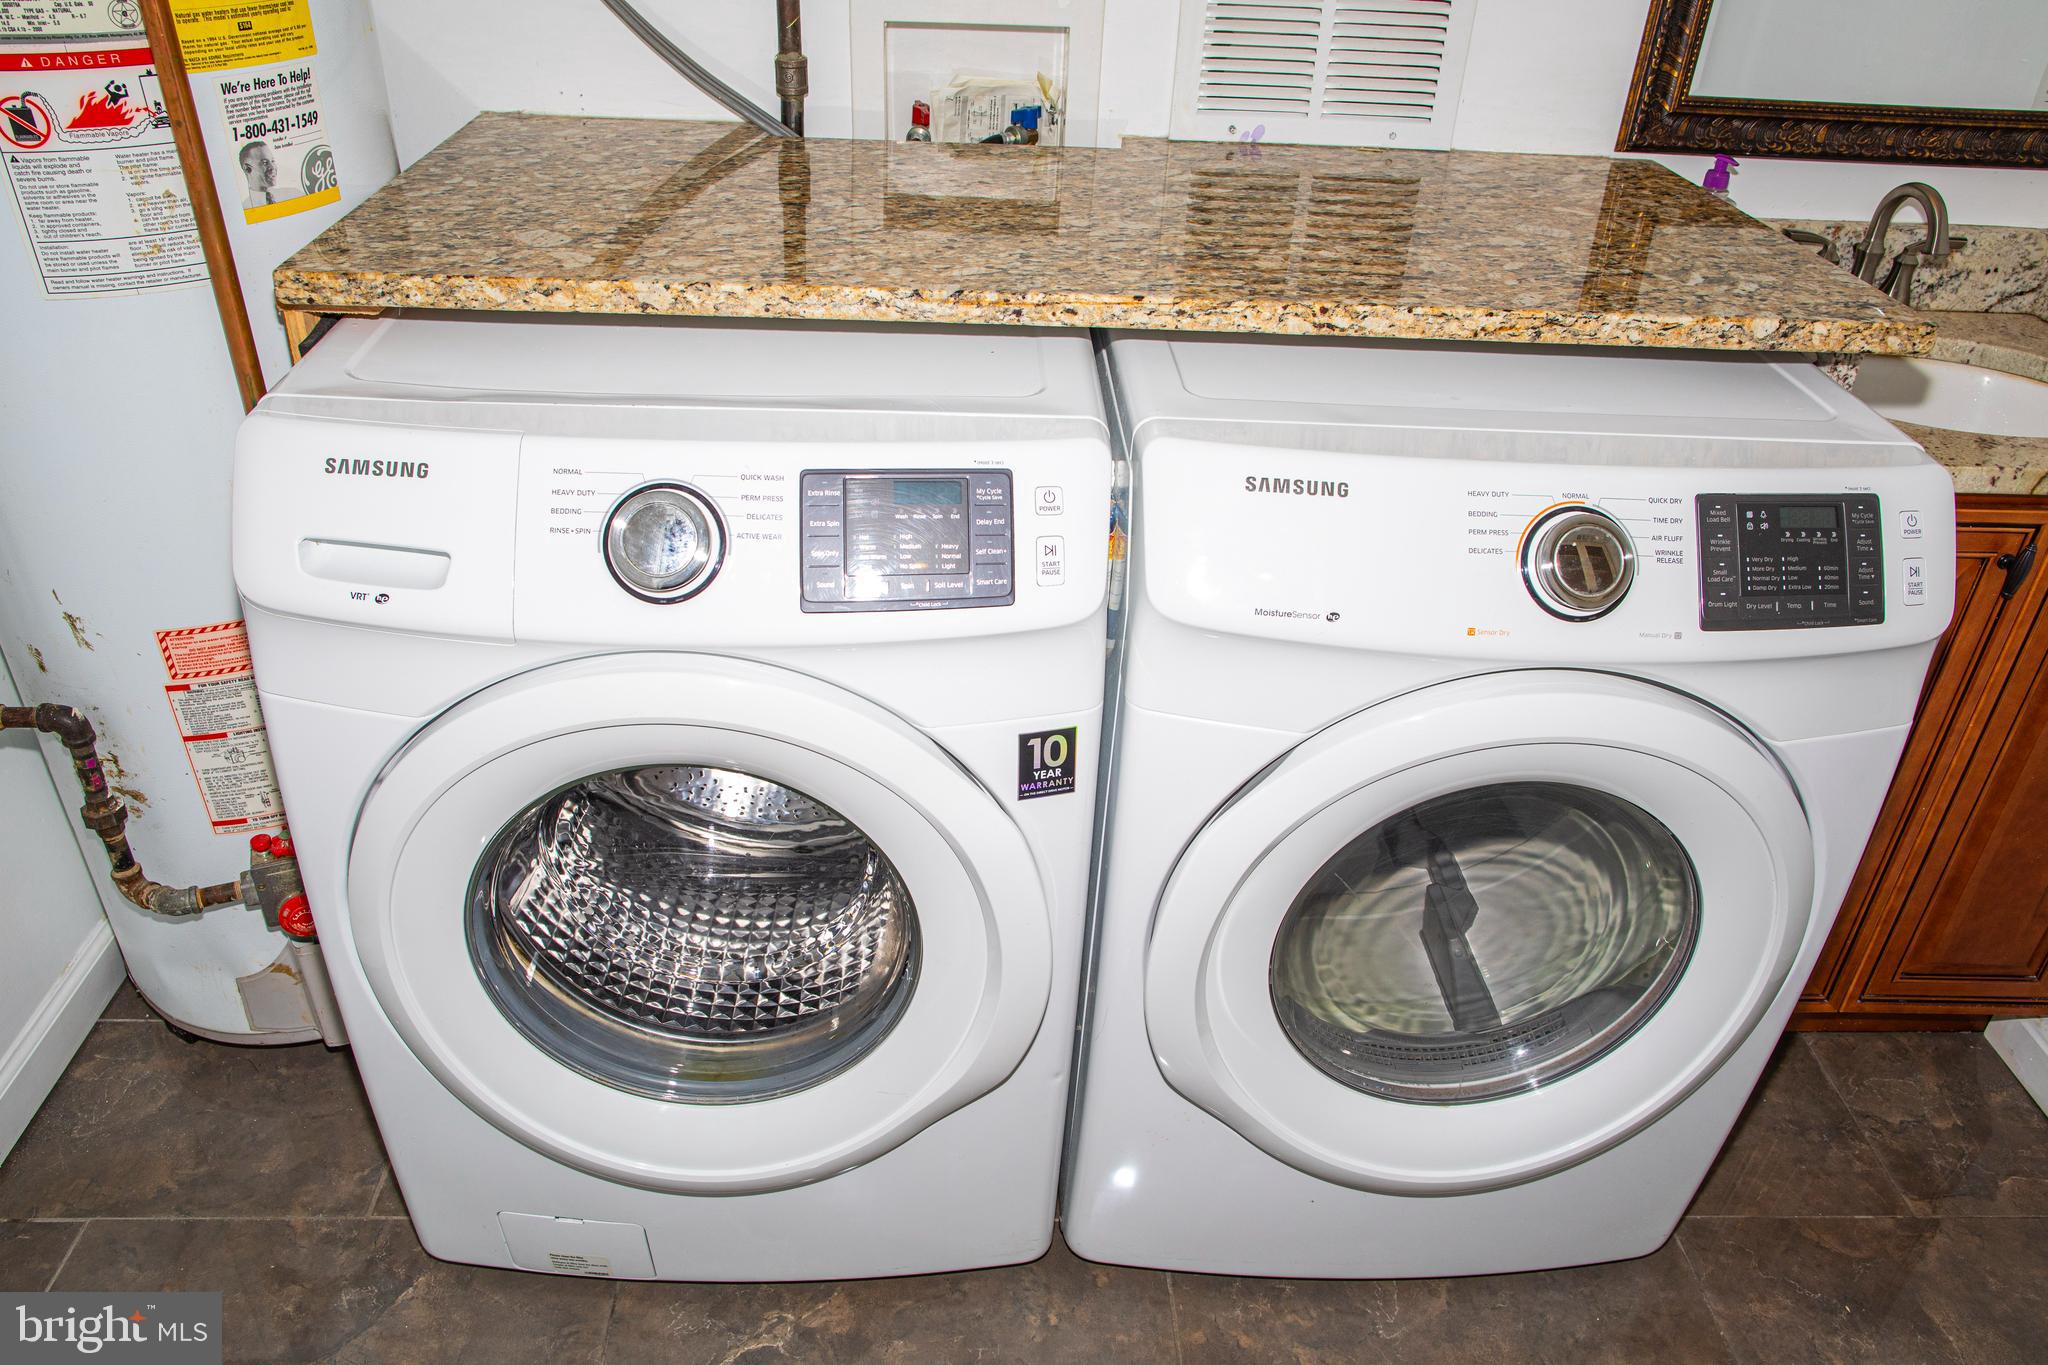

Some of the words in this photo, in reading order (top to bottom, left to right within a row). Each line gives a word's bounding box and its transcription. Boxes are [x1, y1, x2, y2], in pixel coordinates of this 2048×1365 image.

[40, 54, 120, 68] DANGER
[220, 80, 250, 96] We're
[253, 78, 276, 90] Here
[277, 74, 287, 85] To
[289, 67, 311, 84] Help!
[232, 110, 318, 142] 1-800-431-1549
[69, 131, 105, 139] Flammable
[106, 130, 129, 138] Vapors
[324, 457, 429, 479] SAMSUNG
[986, 488, 1002, 496] Cycle
[1245, 476, 1350, 498] SAMSUNG
[737, 532, 760, 540] ACTIVE
[1498, 629, 1510, 637] Dry
[1027, 734, 1068, 769] 10
[1033, 768, 1062, 780] YEAR
[1020, 777, 1074, 791] WARRANTY
